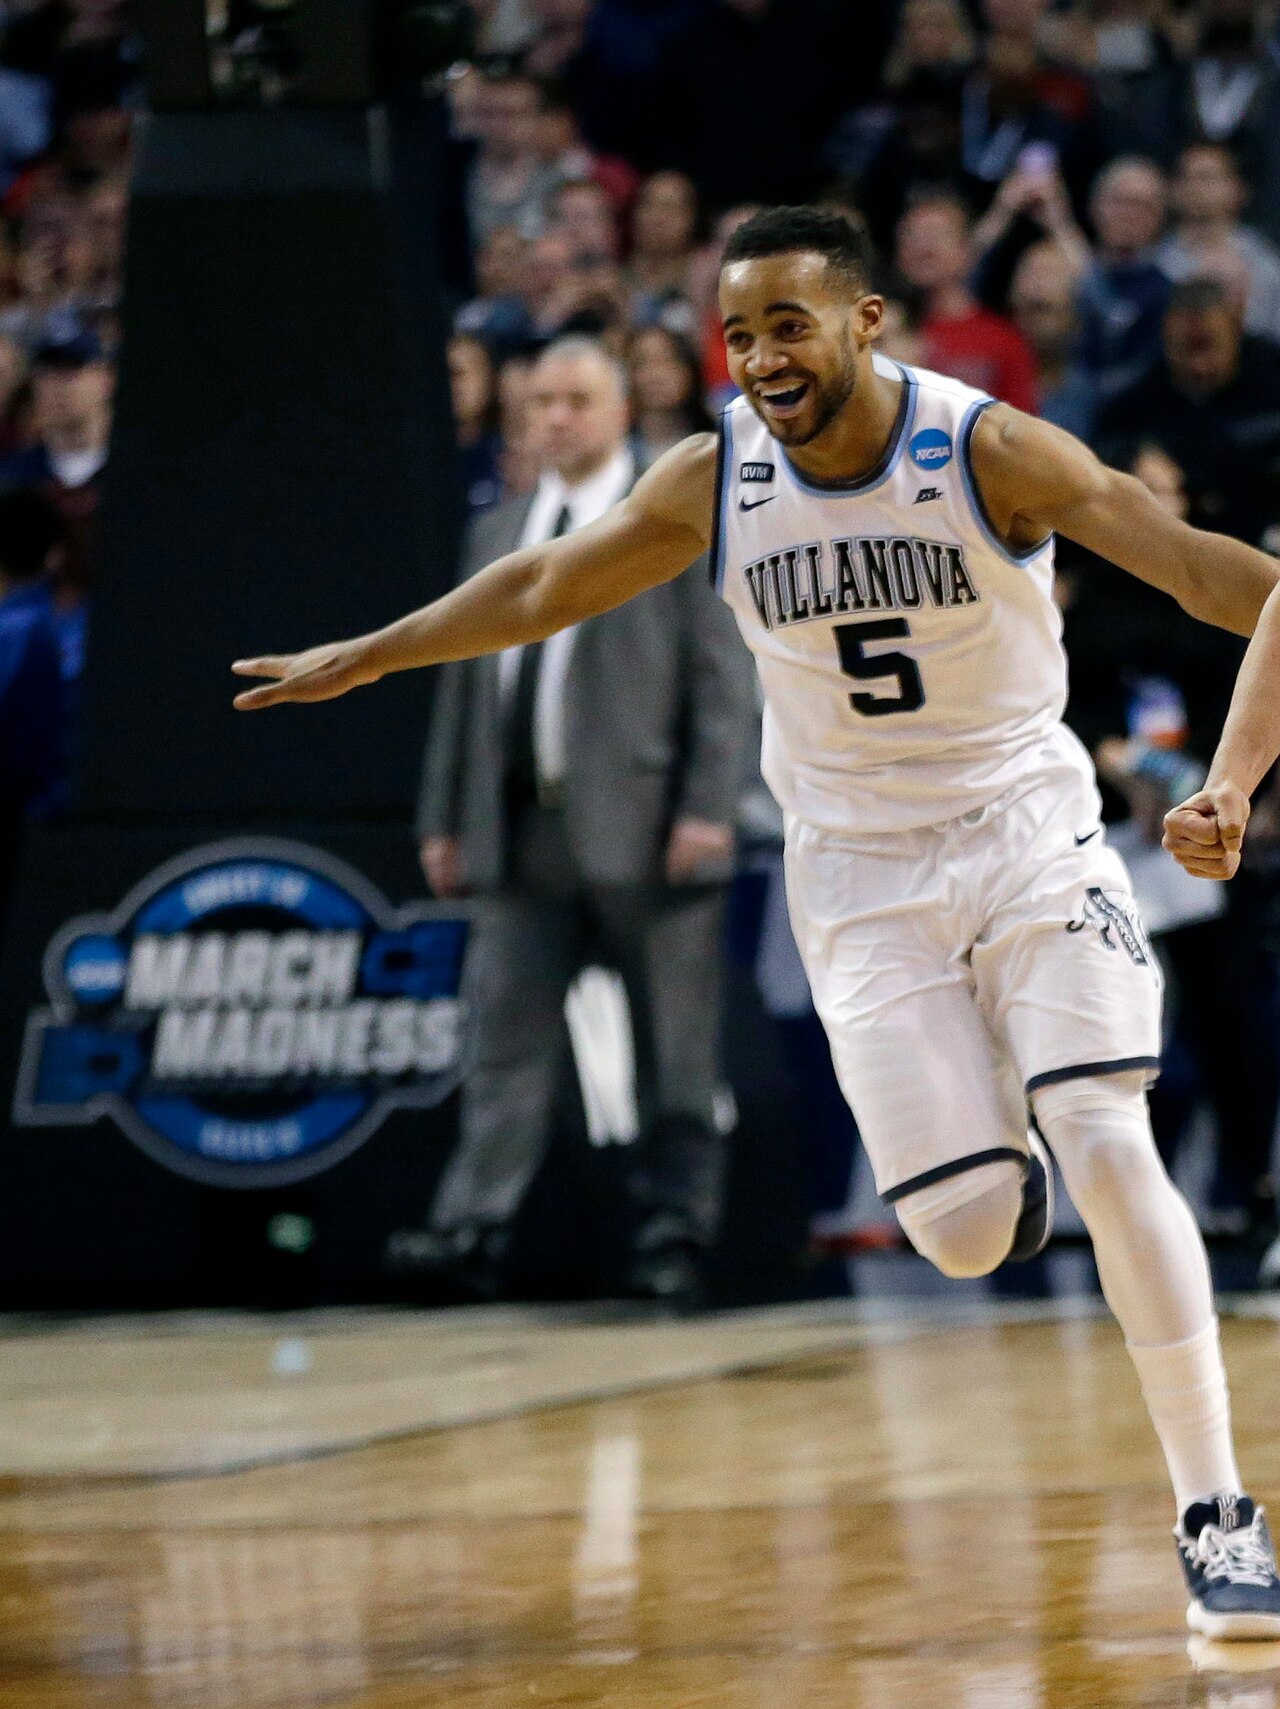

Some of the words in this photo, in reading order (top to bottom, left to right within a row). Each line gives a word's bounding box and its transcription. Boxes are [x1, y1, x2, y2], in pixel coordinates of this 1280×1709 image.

[742, 466, 769, 479] RVM
[743, 536, 980, 632] VILLANOVA
[832, 617, 926, 717] 5
[125, 931, 364, 1010] MARCH
[151, 997, 461, 1079] MADNESS
